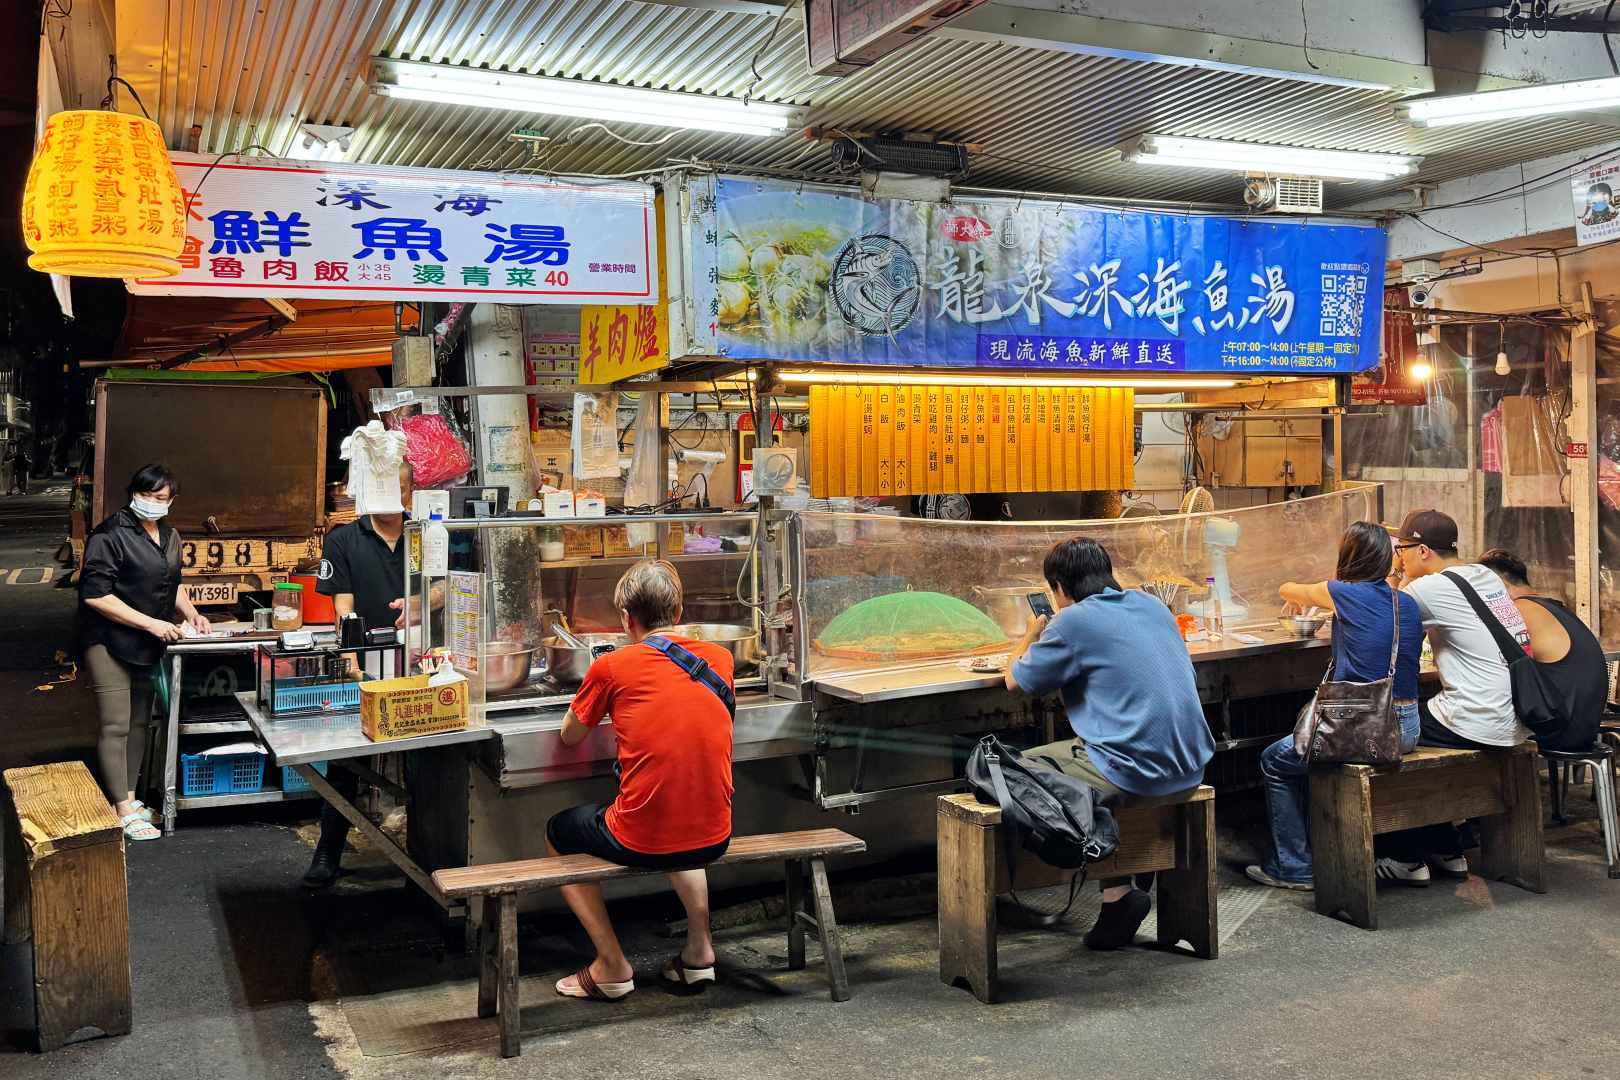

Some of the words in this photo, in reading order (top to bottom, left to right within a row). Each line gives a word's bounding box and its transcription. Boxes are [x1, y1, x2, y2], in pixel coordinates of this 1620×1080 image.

[316, 178, 502, 216] 深海
[208, 210, 571, 266] 鮮魚湯
[208, 256, 350, 283] 魯肉飯
[358, 264, 371, 273] 小
[373, 264, 391, 273] 35
[358, 273, 371, 281] 大
[373, 273, 392, 282] 45
[412, 263, 538, 289] 燙青菜
[544, 270, 569, 288] 40
[588, 262, 637, 275] 營業時間
[930, 256, 1296, 338] 龍泉深海魚湯
[989, 338, 1177, 367] 現流海魚新鮮直送
[181, 541, 273, 568] 3981
